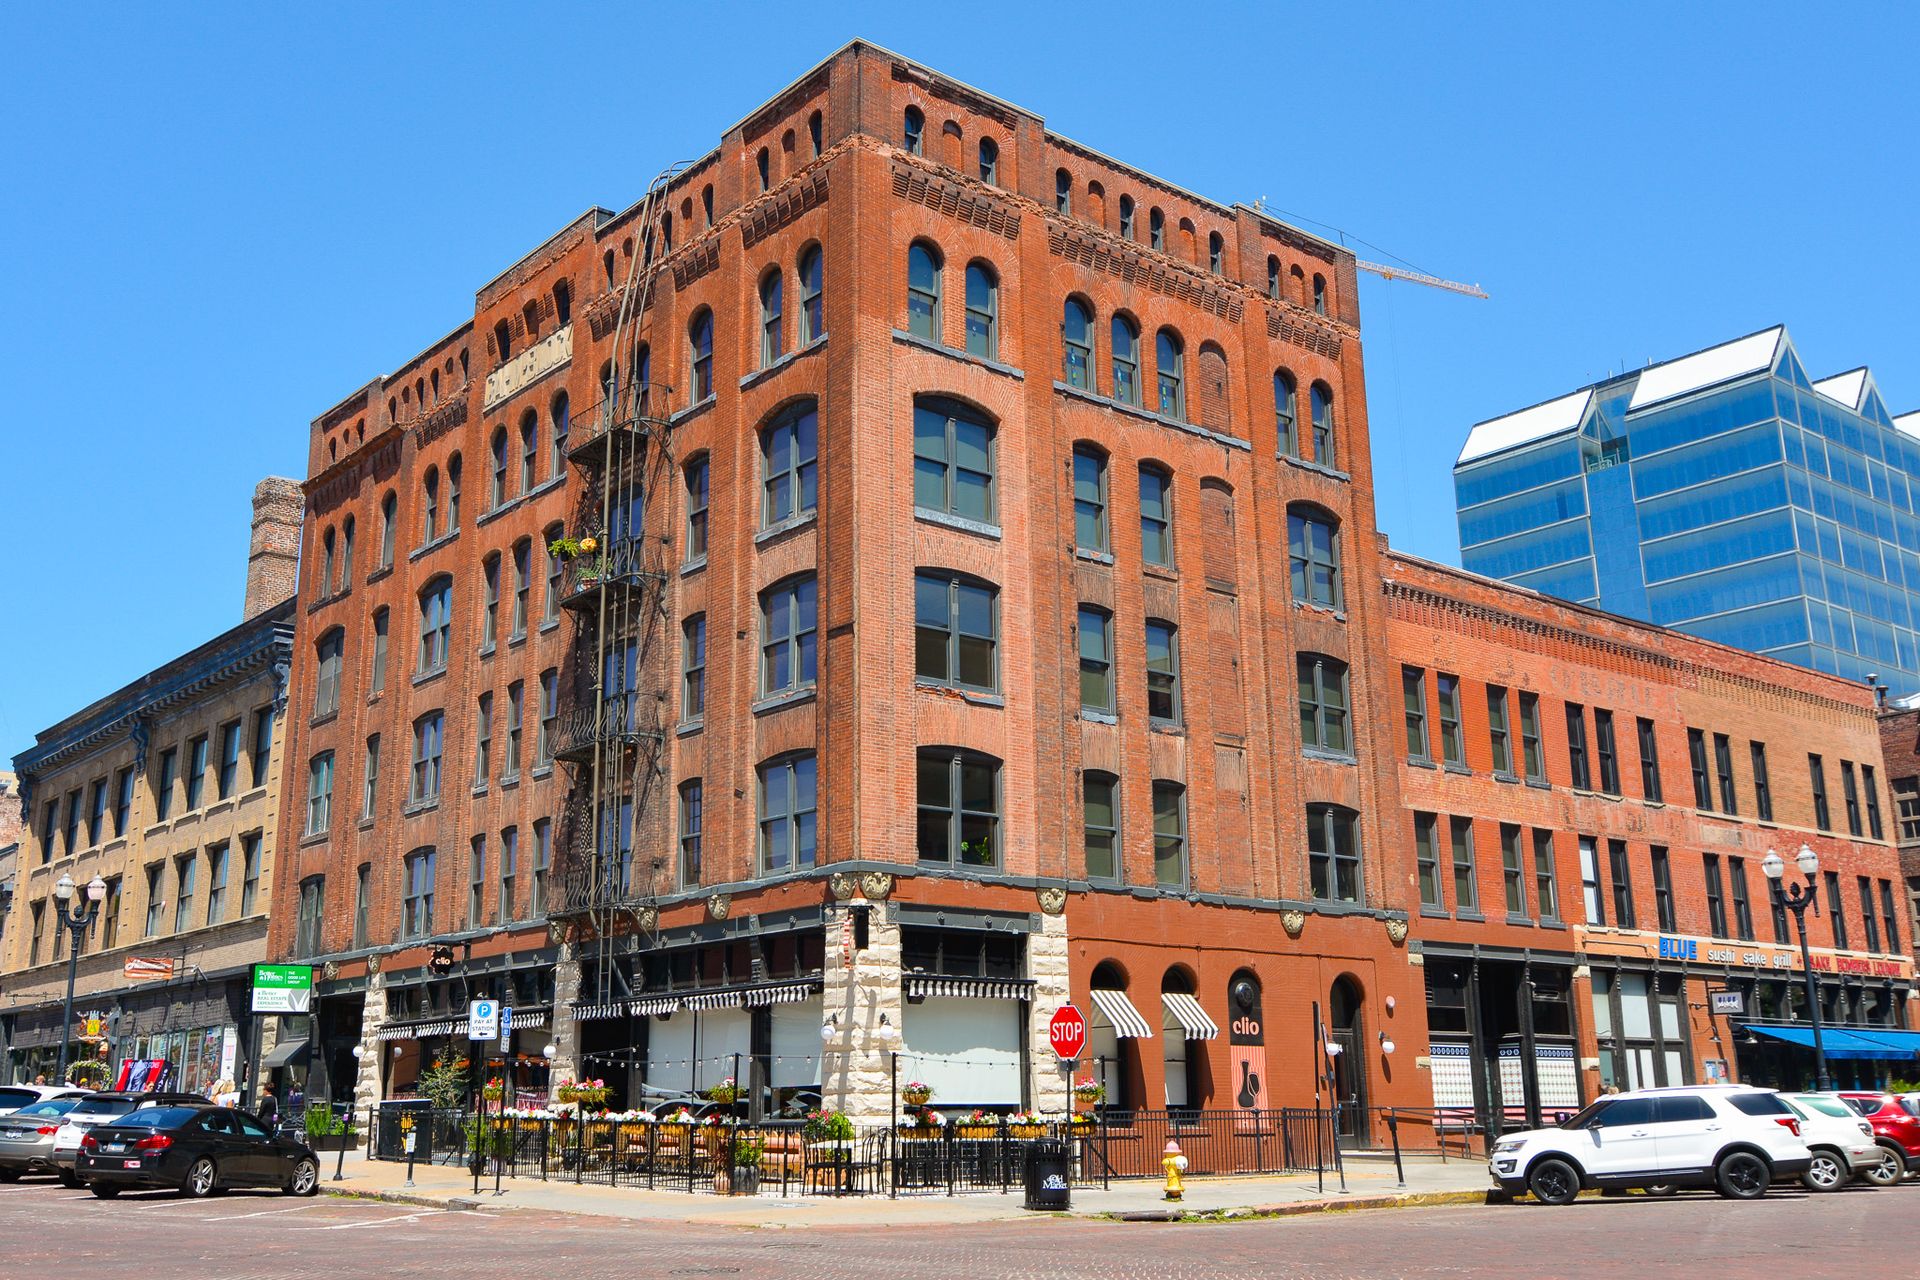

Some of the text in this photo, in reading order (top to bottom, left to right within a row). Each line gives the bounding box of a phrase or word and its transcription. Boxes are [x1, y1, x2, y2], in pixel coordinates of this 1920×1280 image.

[1659, 936, 1697, 959] BLUE
[1708, 949, 1735, 963] sushi
[1743, 951, 1766, 966] sake
[1773, 950, 1792, 968] grill
[1809, 955, 1831, 971] SAKE
[1051, 1021, 1082, 1042] STOP
[1232, 1016, 1259, 1035] clio
[1042, 1179, 1068, 1189] Market
[1046, 1174, 1063, 1183] Old
